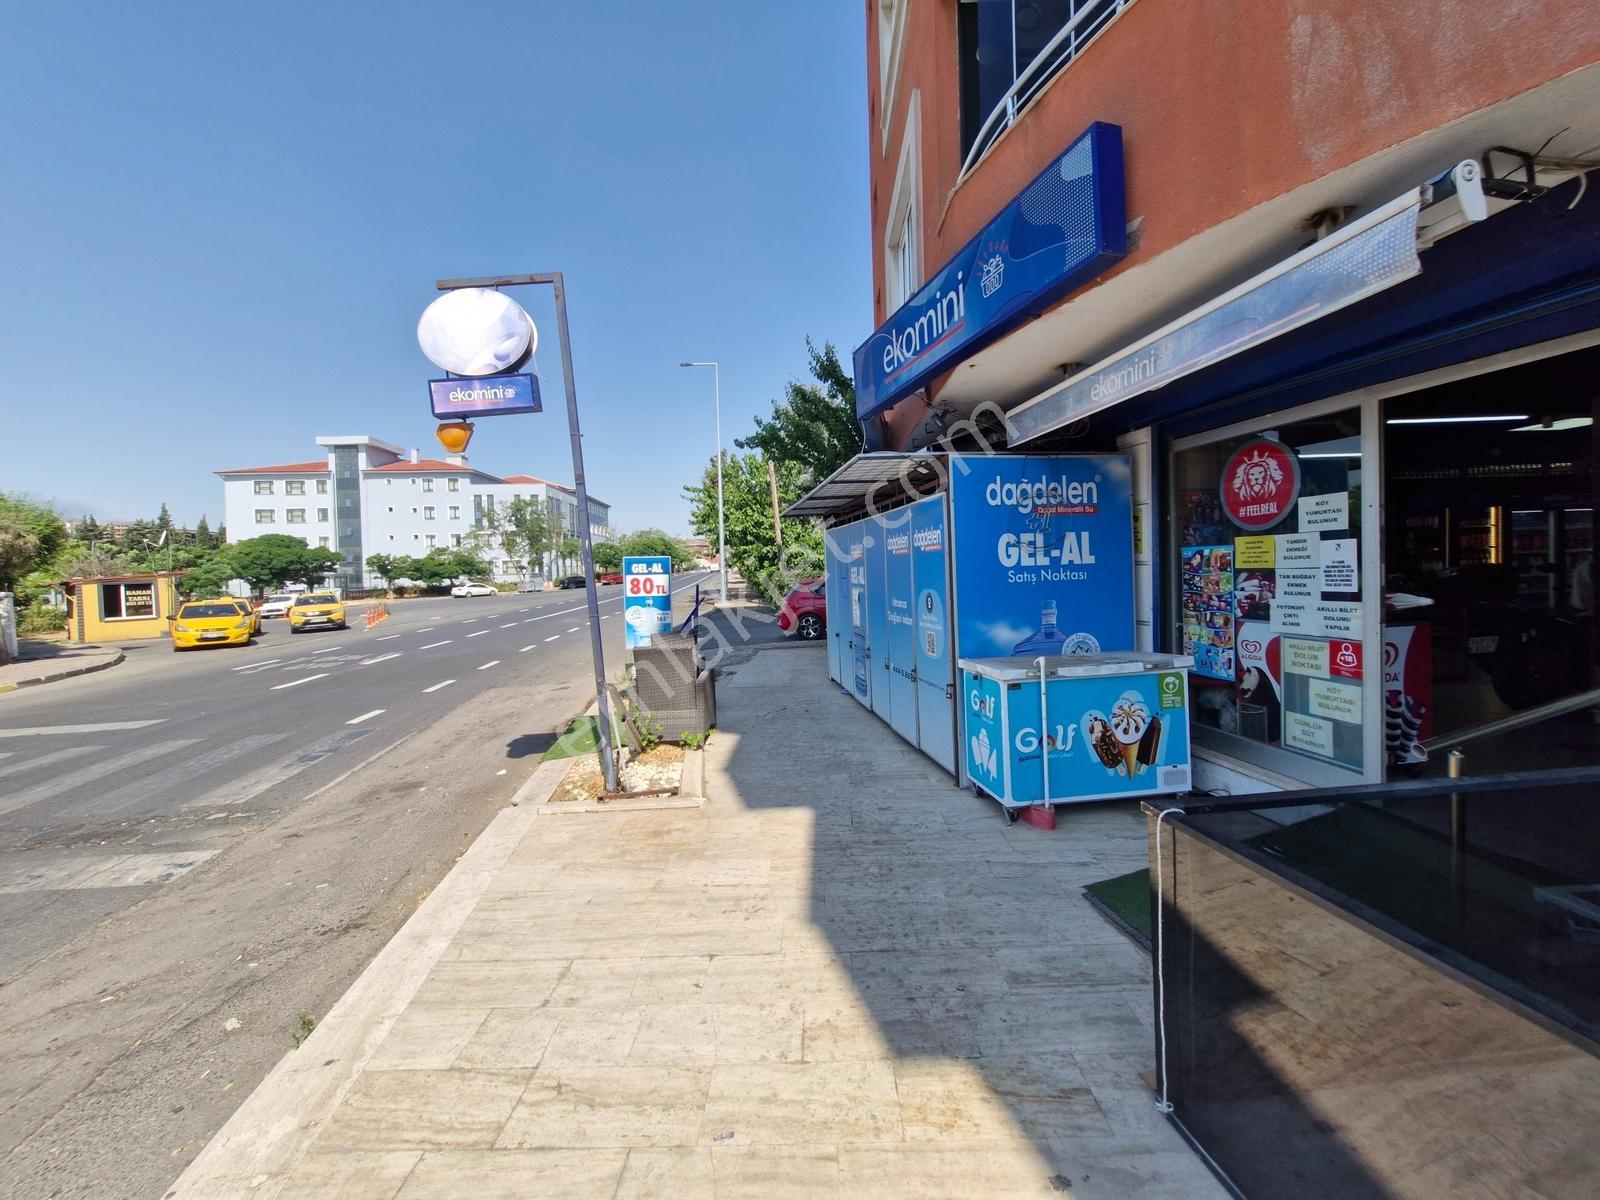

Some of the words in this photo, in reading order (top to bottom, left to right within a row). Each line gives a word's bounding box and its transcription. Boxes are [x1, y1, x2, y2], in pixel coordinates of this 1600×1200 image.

[883, 270, 965, 373] ekomini
[1091, 349, 1154, 401] ekomini
[449, 385, 504, 402] ekomini
[1084, 504, 1094, 513] Su
[1239, 502, 1278, 518] #FEELREAL
[1305, 507, 1342, 517] YUMURTASI
[1307, 517, 1338, 525] BULUNUR
[997, 531, 1096, 568] GEL-AL
[631, 562, 664, 574] GEL-AL
[1007, 570, 1037, 585] Satış
[1040, 567, 1088, 581] Noktası
[630, 577, 655, 595] 80
[655, 584, 667, 594] TL
[970, 689, 996, 719] Golf
[1015, 723, 1078, 753] Golf
